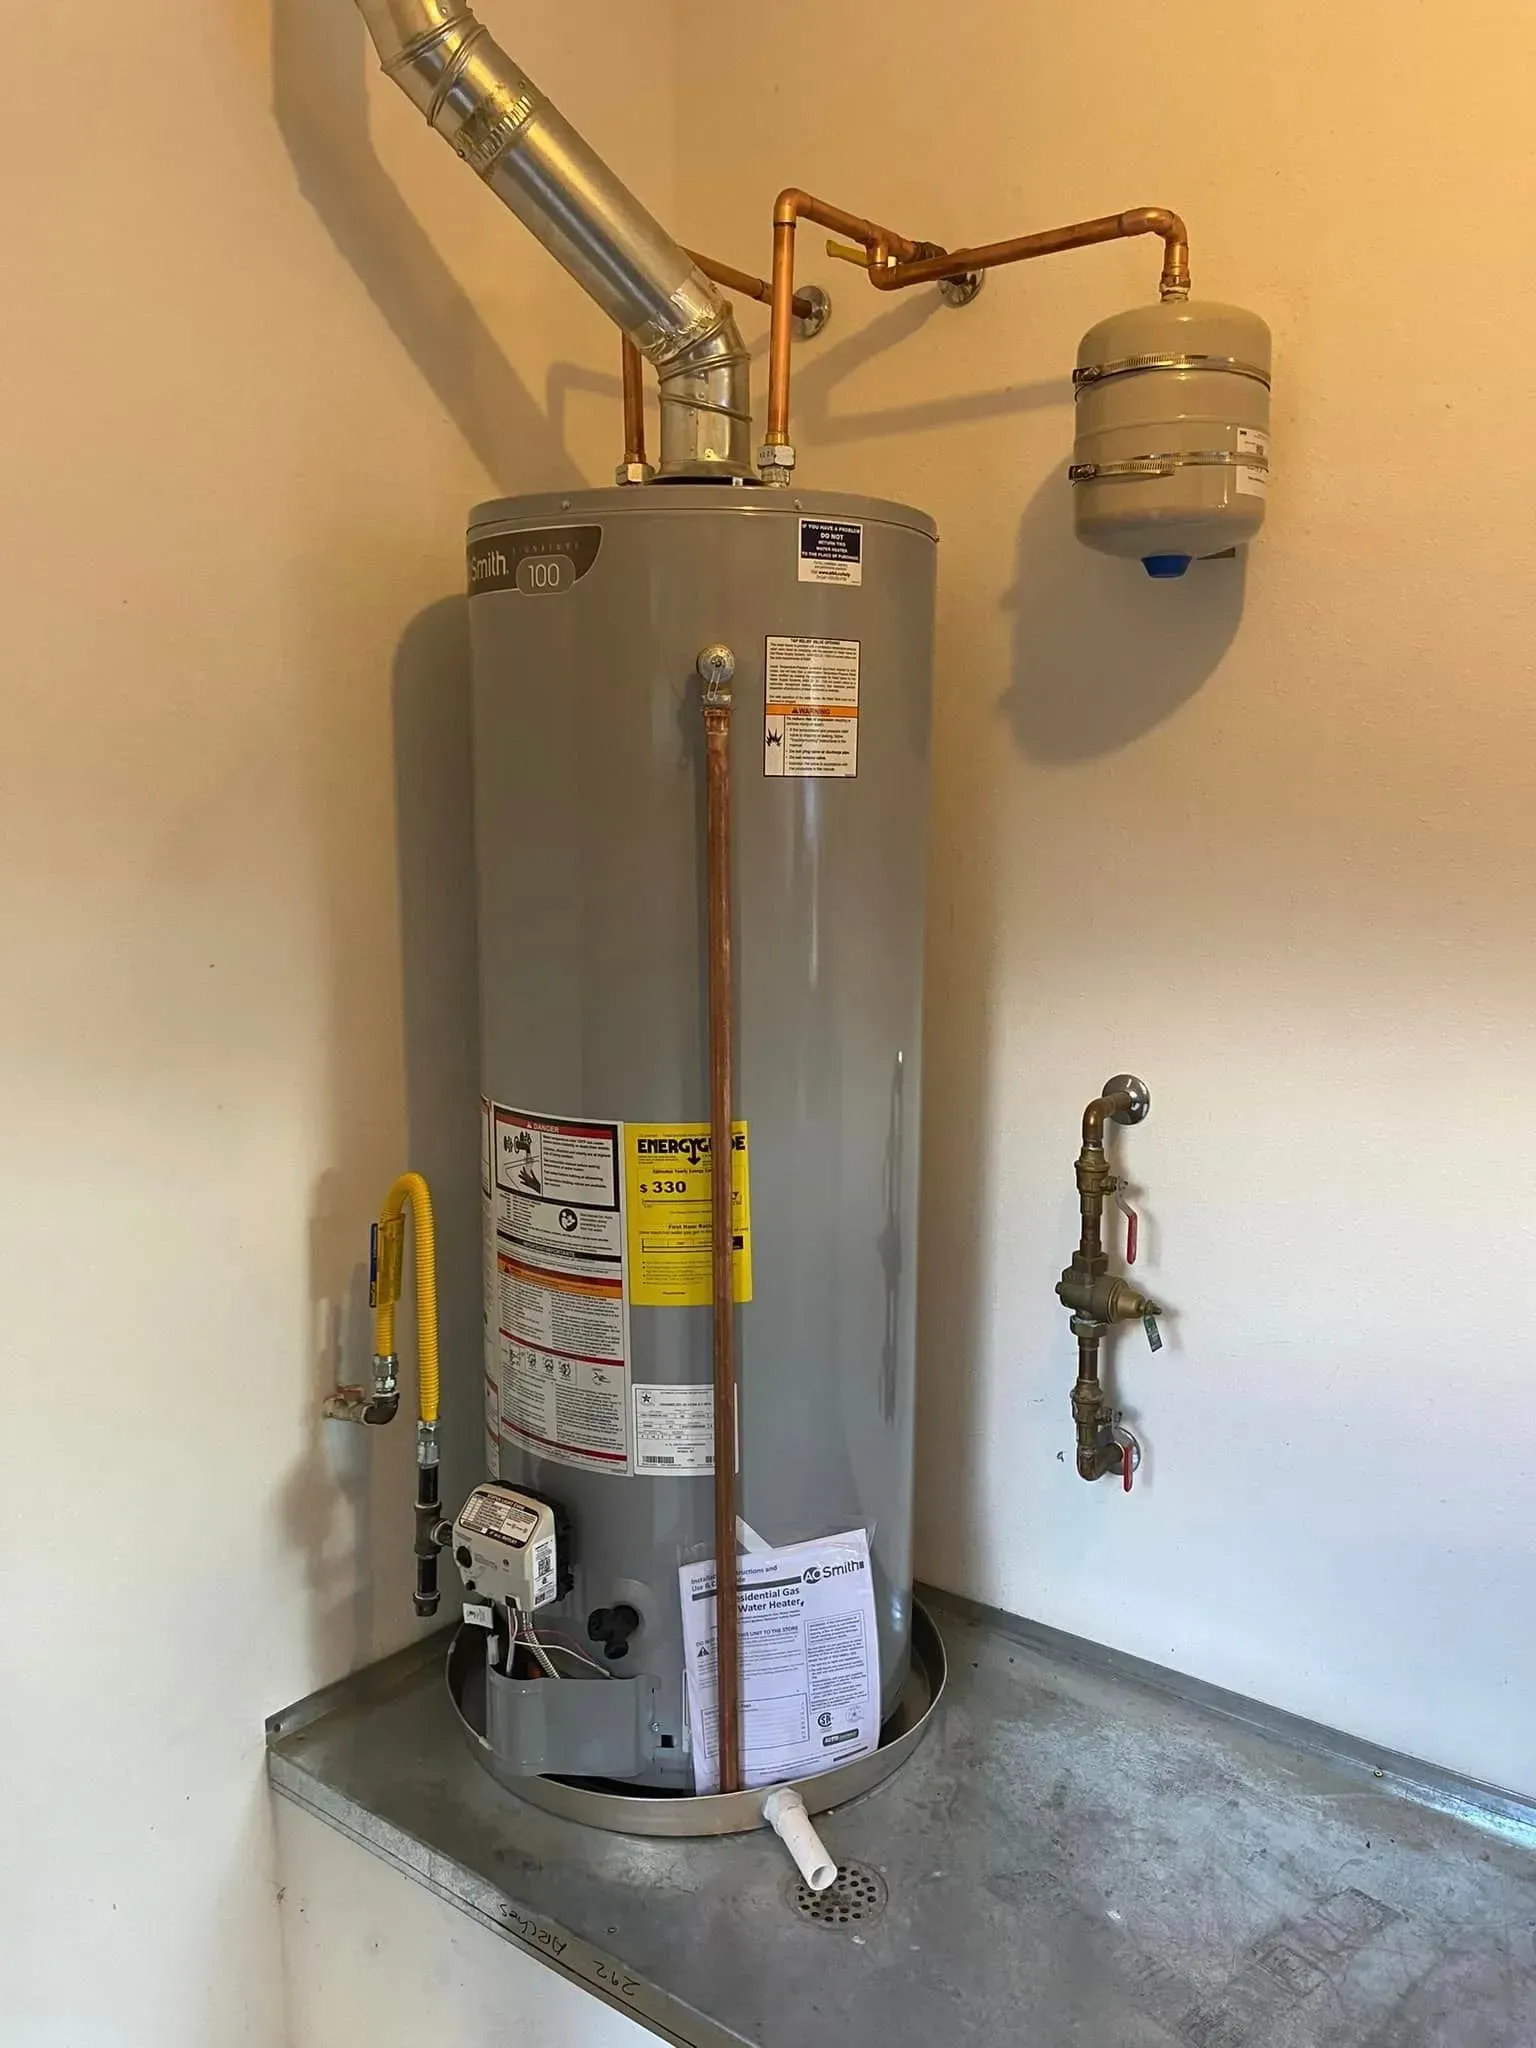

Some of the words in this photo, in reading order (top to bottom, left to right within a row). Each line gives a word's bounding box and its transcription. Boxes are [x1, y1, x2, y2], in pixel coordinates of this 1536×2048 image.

[831, 533, 844, 541] NOT
[528, 562, 560, 588] 100
[799, 707, 831, 715] WARNING
[533, 1123, 560, 1133] DANGER
[640, 1184, 648, 1194] $
[652, 1181, 687, 1194] 330
[765, 1564, 778, 1573] and
[822, 1560, 860, 1578] Smith
[782, 1587, 800, 1597] Gas
[738, 1603, 767, 1613] Water
